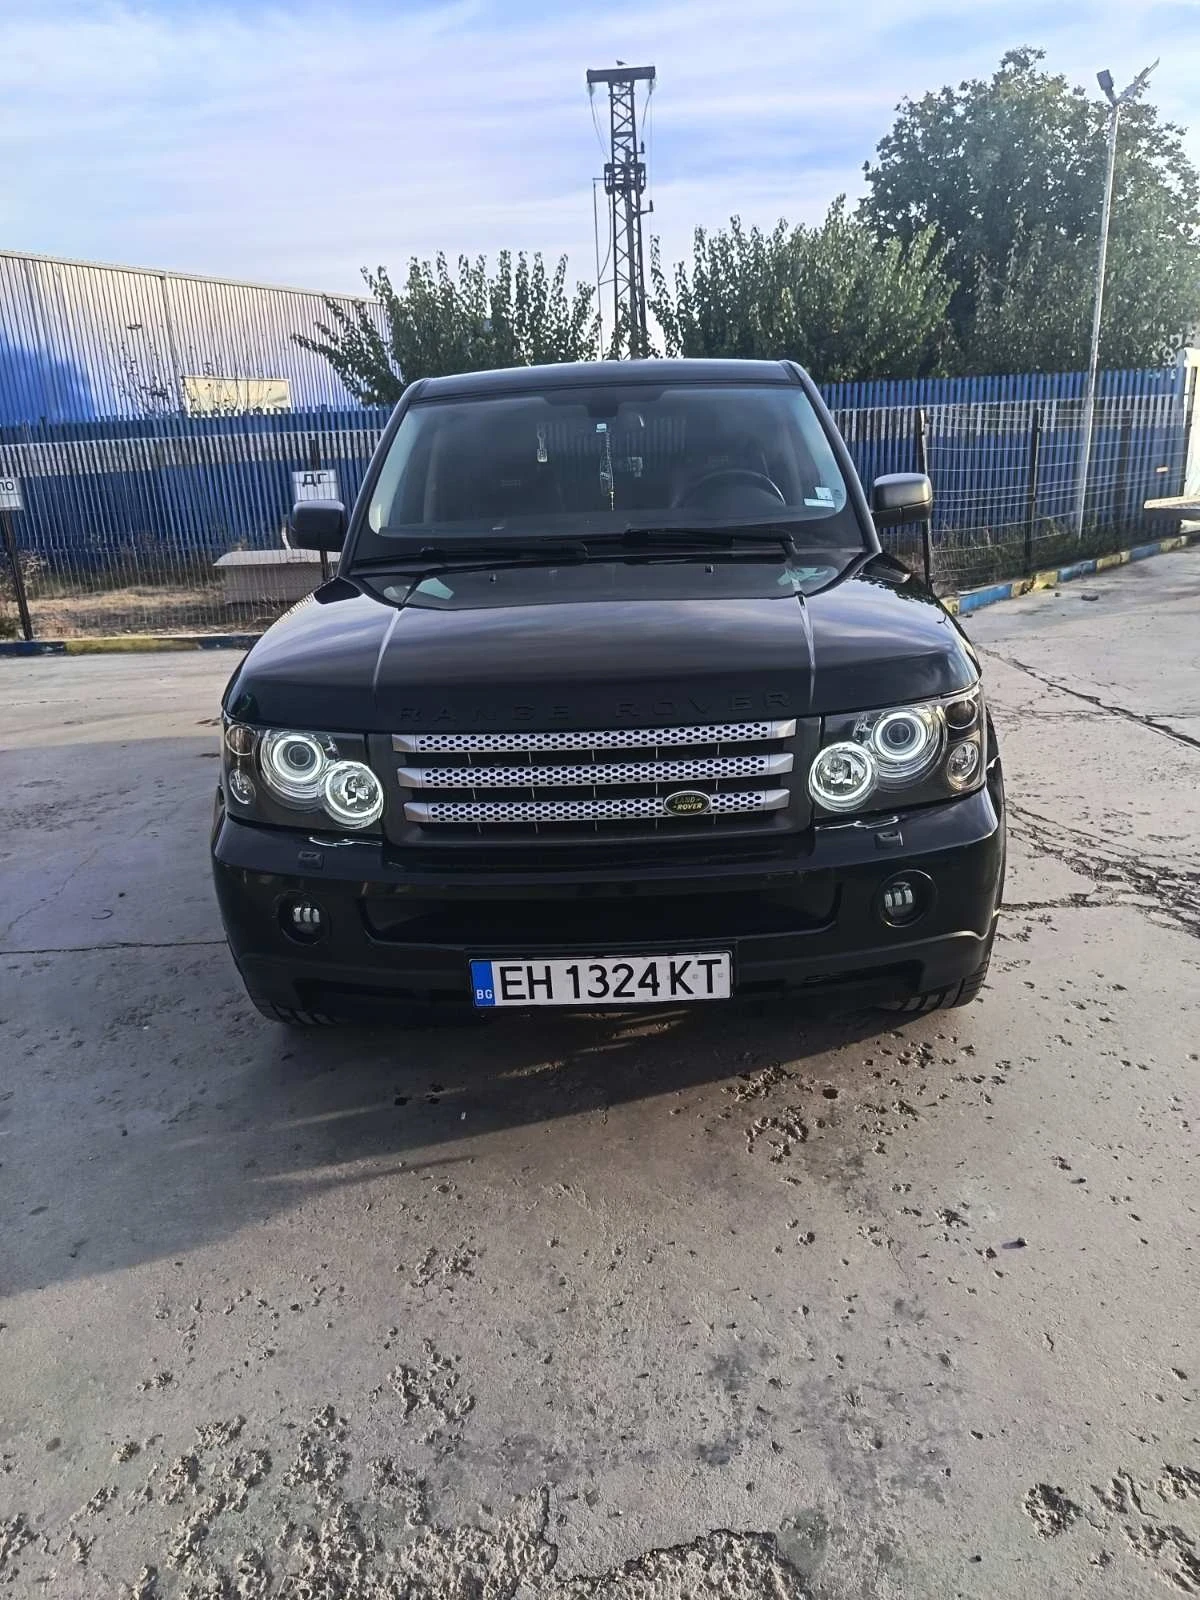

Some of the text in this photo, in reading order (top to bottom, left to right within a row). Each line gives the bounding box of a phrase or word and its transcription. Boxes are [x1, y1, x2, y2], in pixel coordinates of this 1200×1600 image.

[399, 689, 791, 723] RANGE ROVER
[476, 989, 493, 1000] BG
[500, 959, 722, 1000] EH 1324 KT
